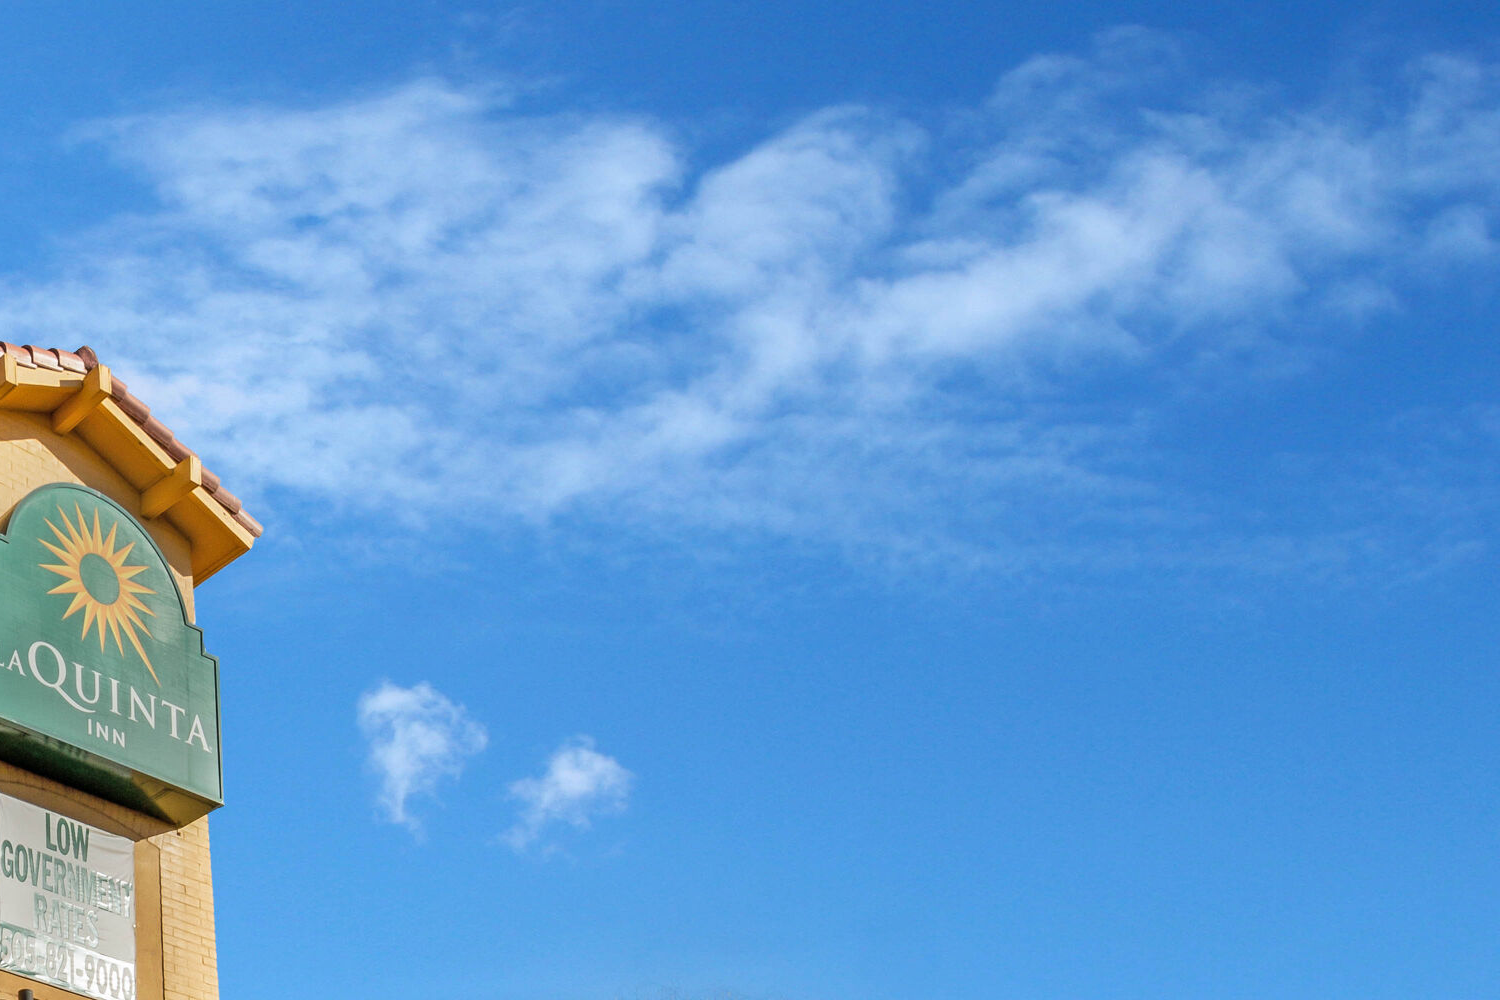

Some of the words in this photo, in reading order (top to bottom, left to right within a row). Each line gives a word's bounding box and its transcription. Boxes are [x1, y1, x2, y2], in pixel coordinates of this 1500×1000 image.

[28, 640, 213, 753] QUINTA
[87, 718, 126, 749] INN
[45, 812, 90, 863] LOW
[0, 839, 133, 919] GOVERNMENT
[33, 892, 99, 949] RATES
